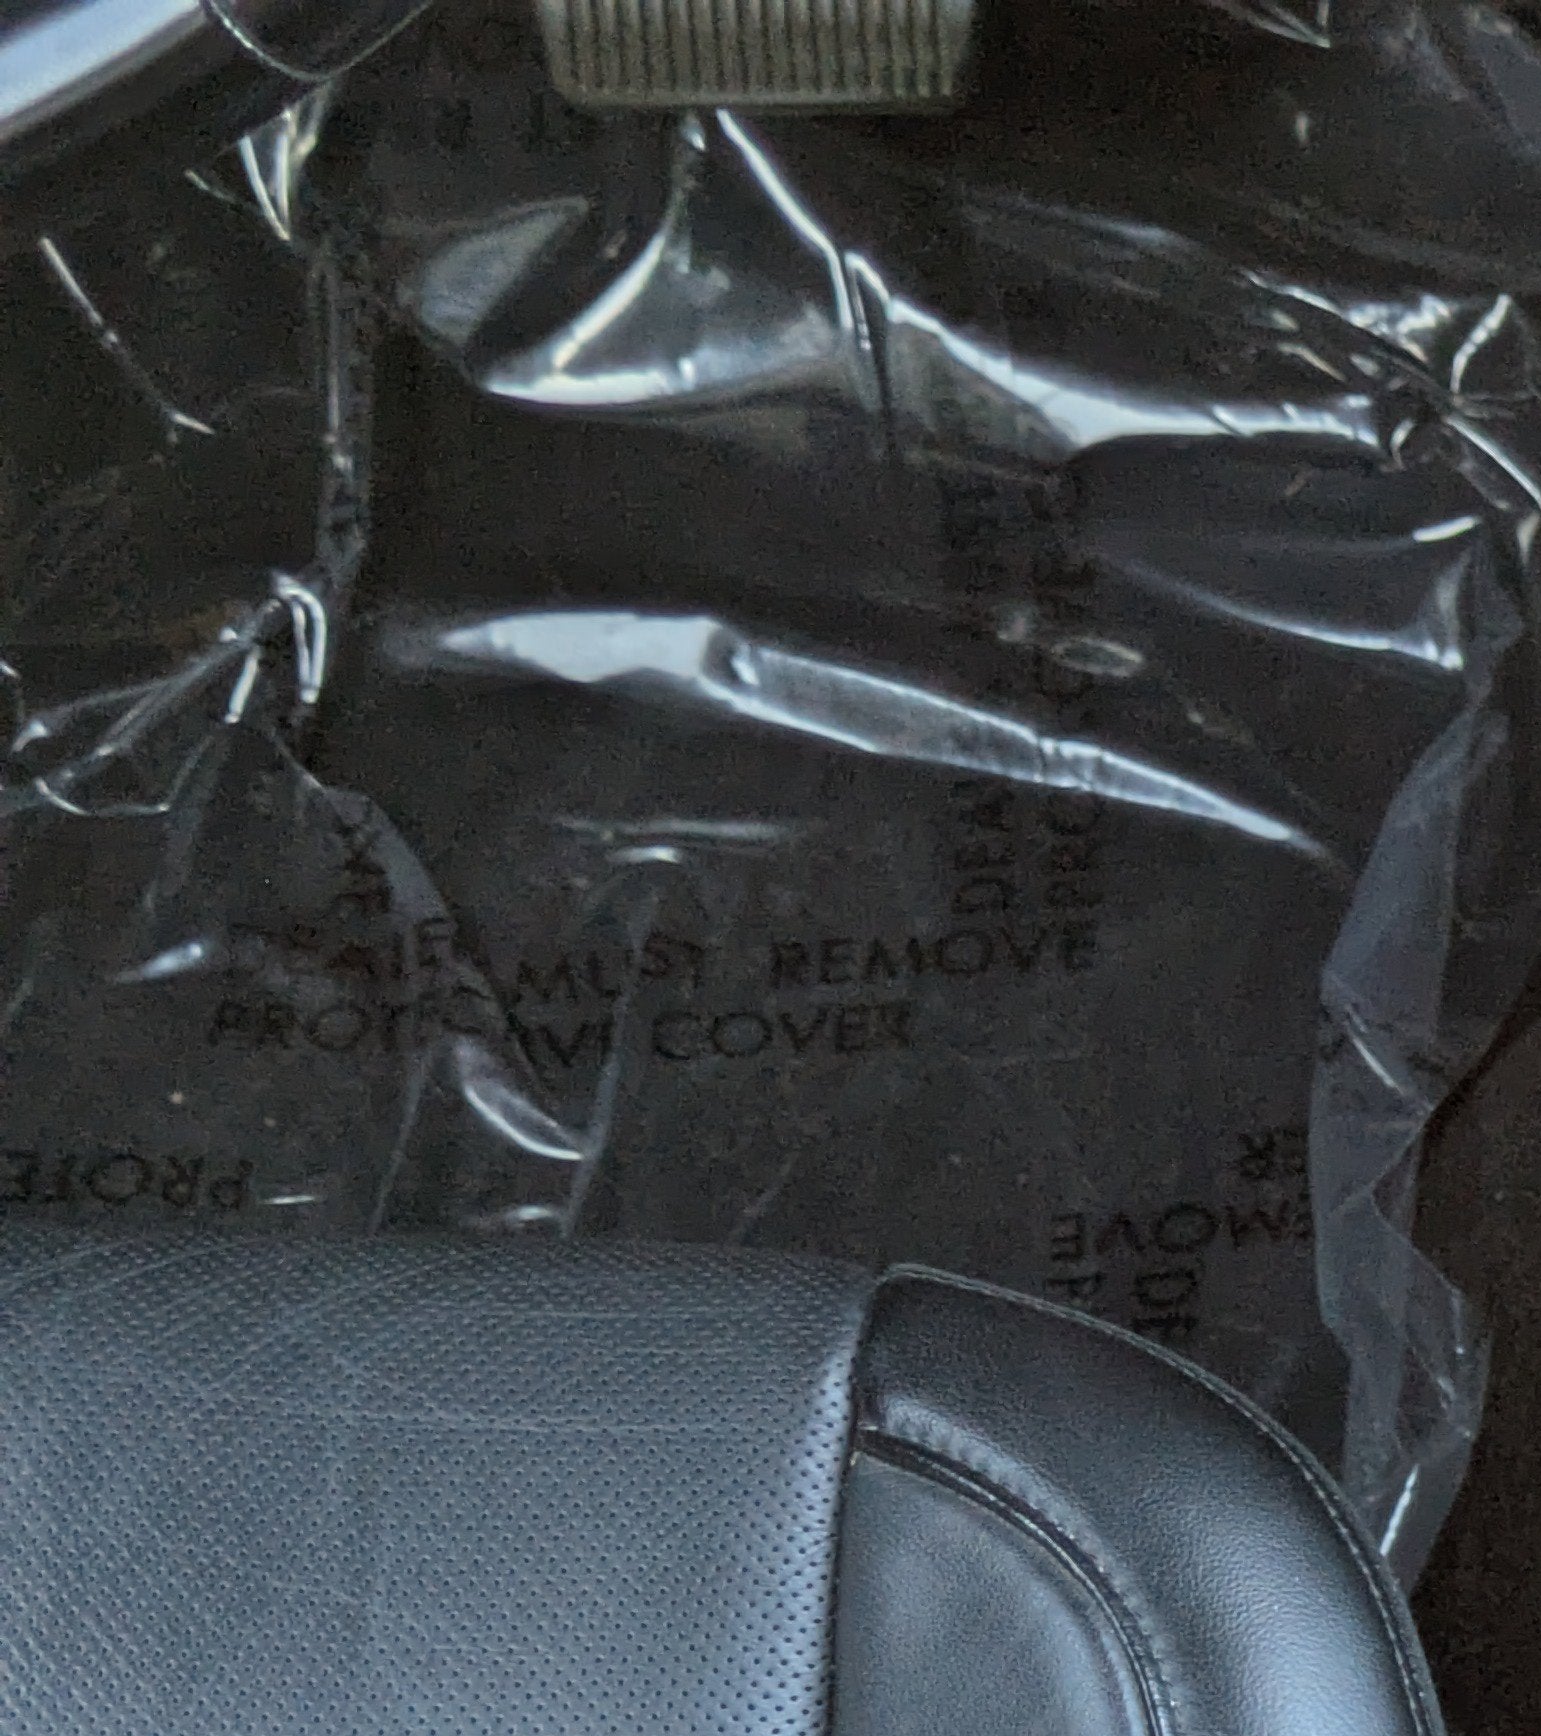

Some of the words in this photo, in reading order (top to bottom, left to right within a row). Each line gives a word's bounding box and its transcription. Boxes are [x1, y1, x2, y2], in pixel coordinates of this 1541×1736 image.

[507, 932, 710, 1004] MUST
[770, 924, 1098, 988] REMOVE
[652, 1002, 913, 1060] COVER
